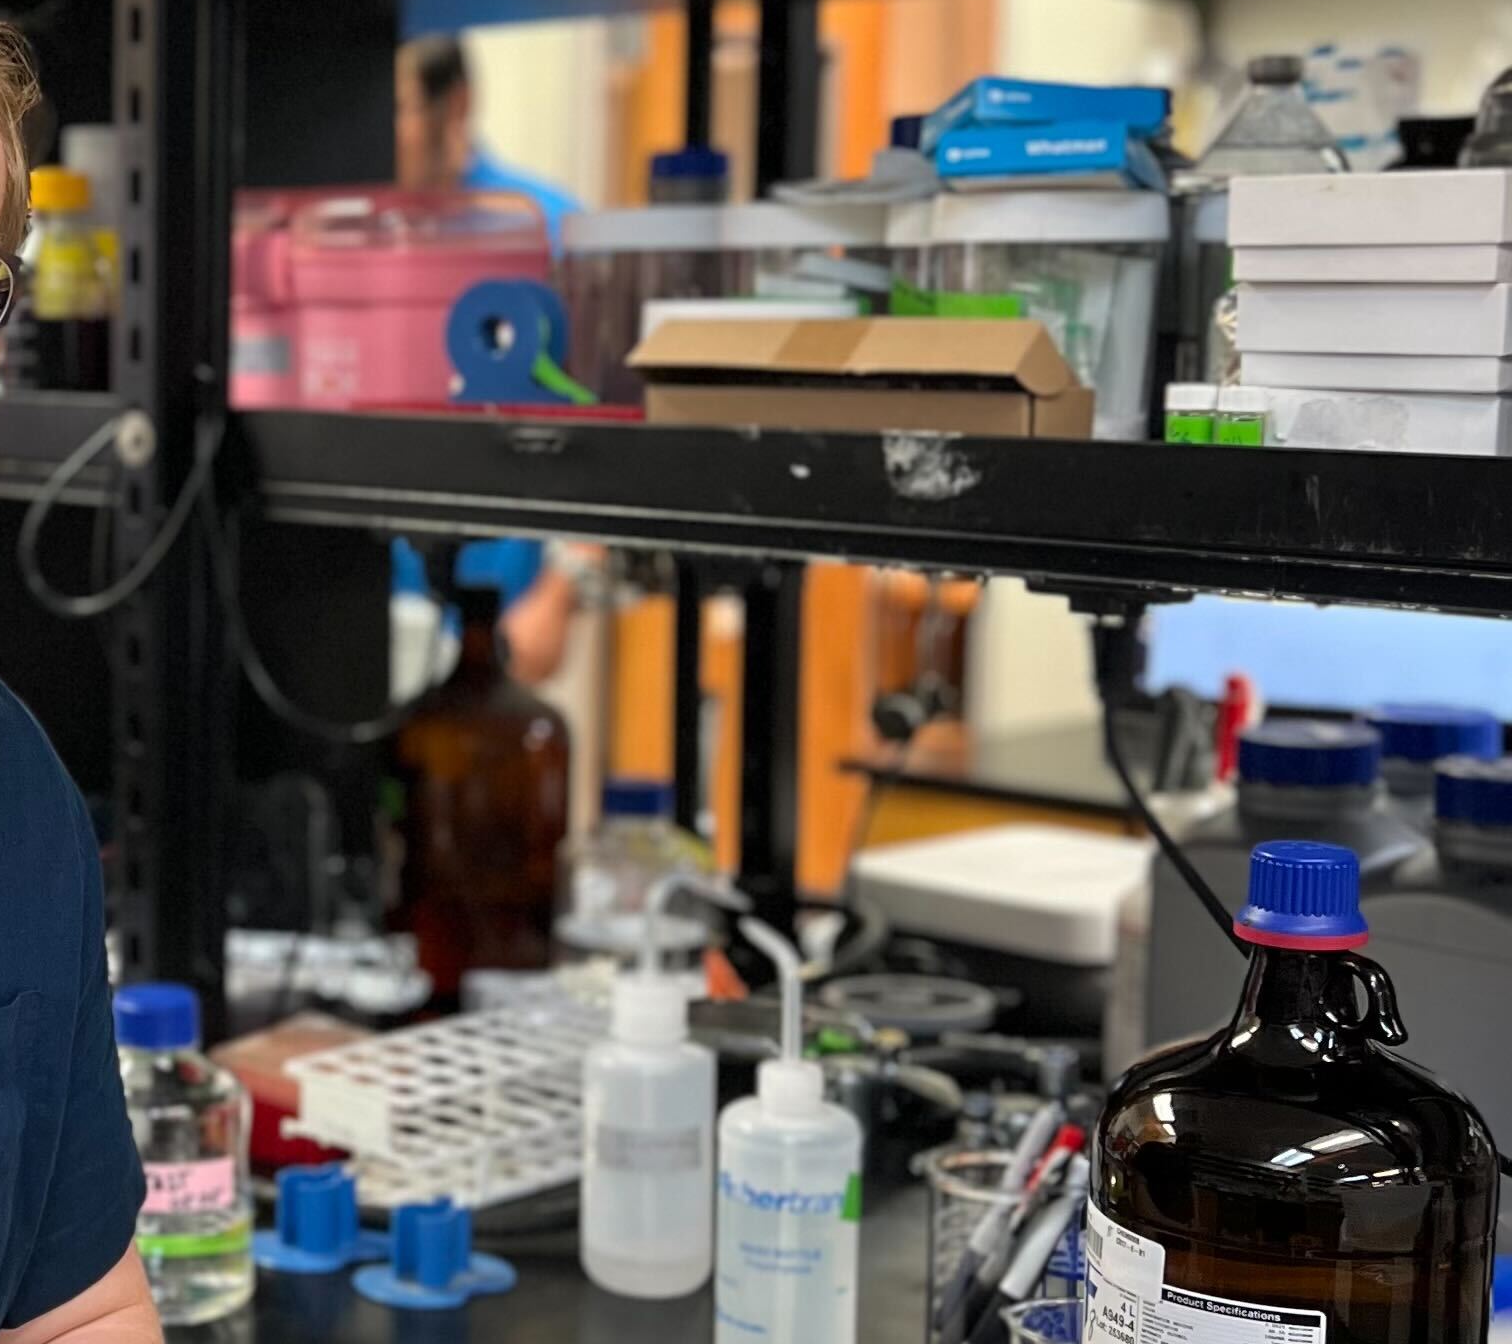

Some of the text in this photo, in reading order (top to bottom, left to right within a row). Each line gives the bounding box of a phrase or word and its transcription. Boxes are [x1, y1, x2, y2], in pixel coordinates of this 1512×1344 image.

[1102, 1305, 1135, 1332] A949-4
[1121, 1302, 1136, 1318] 4 L
[1167, 1291, 1282, 1323] Product Specifications
